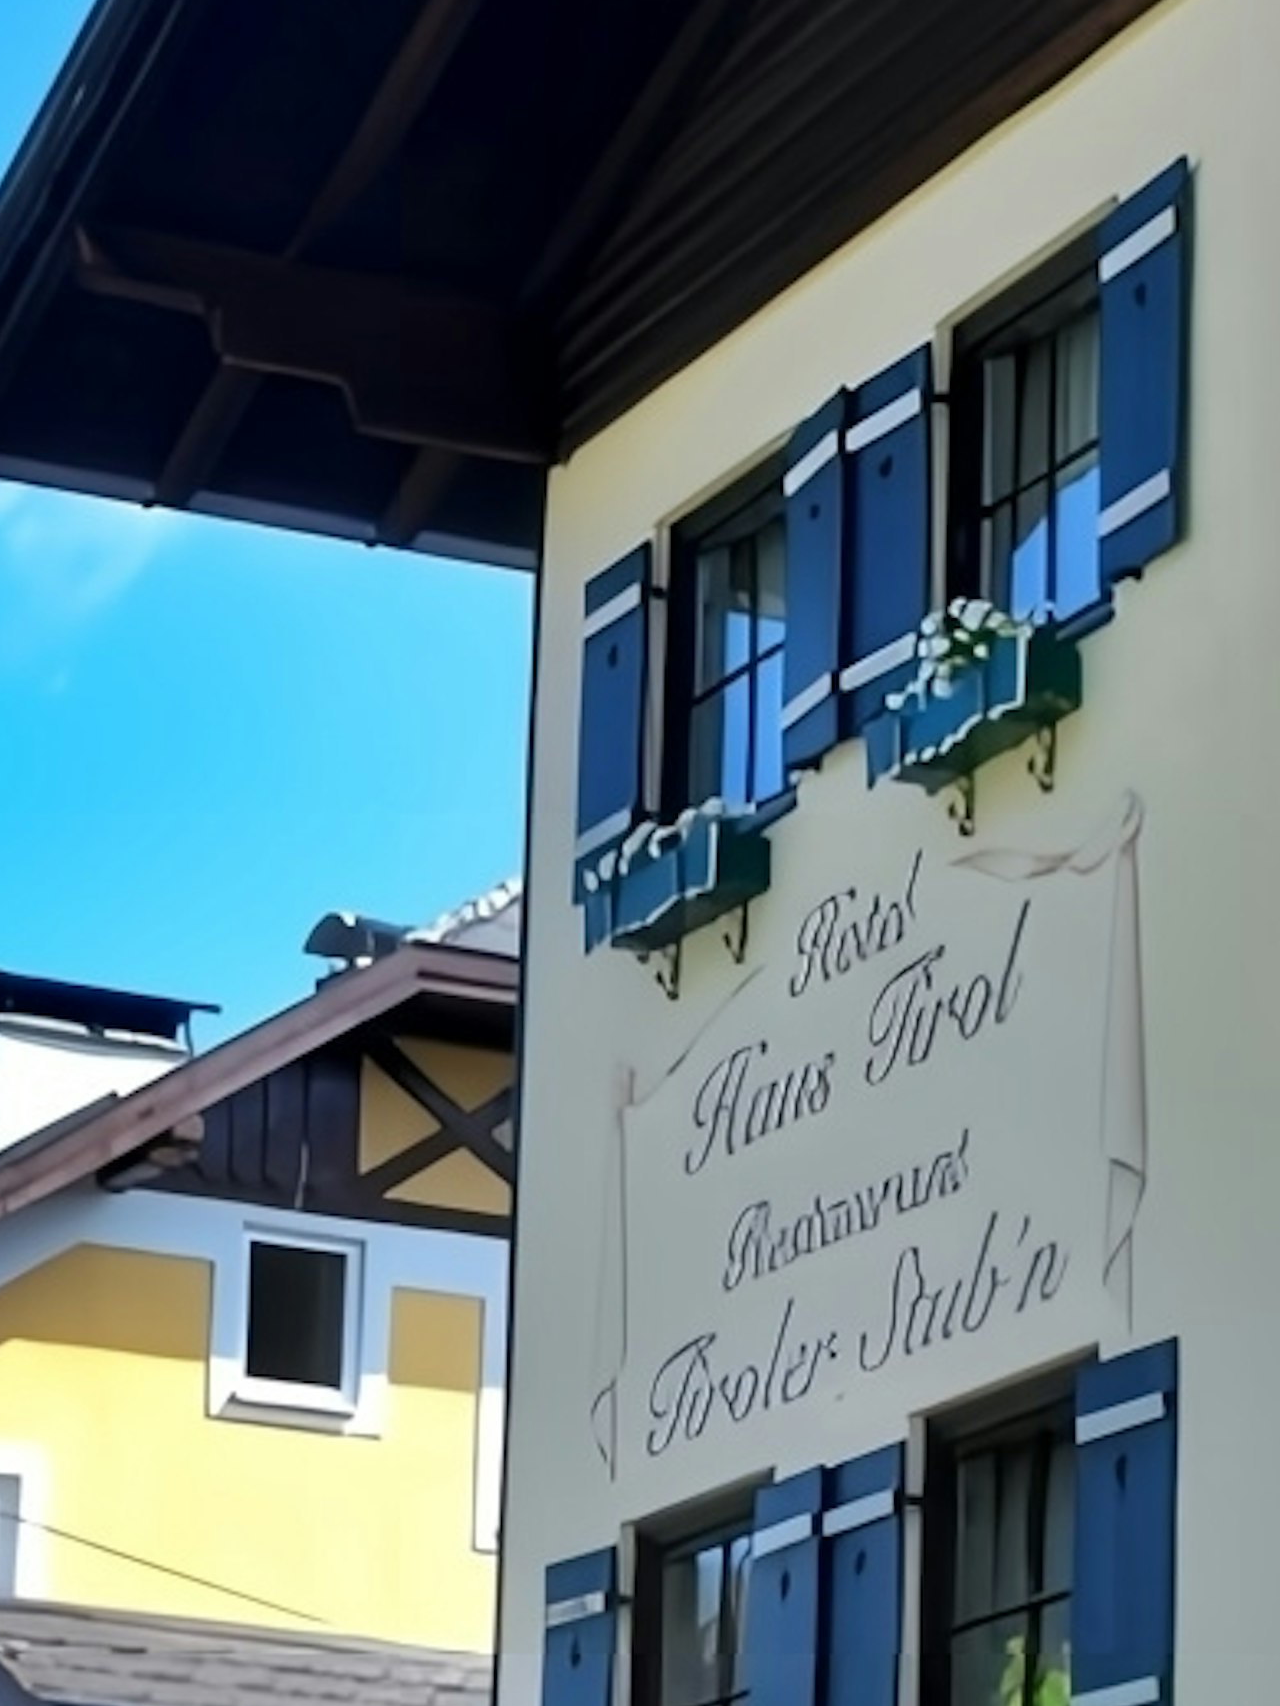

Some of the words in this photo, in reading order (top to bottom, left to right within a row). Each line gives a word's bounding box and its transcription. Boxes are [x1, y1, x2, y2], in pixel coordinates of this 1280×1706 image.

[685, 1040, 835, 1175] Haus
[866, 898, 1031, 1086] Tirol
[647, 1297, 838, 1455] Tiroler
[859, 1210, 1069, 1372] Stub'n
